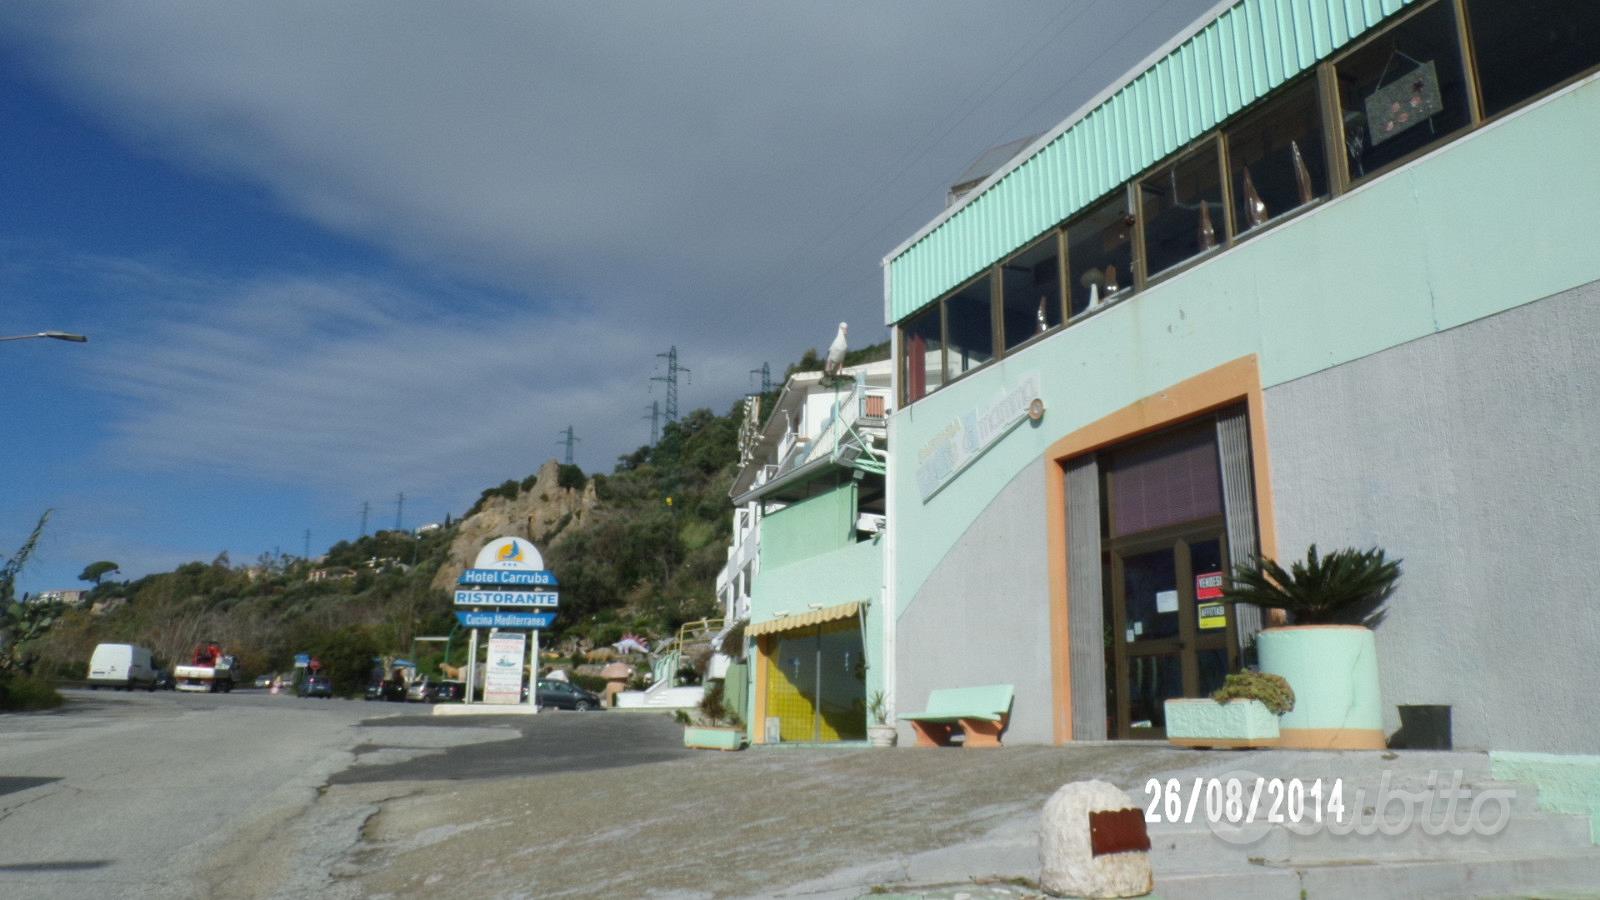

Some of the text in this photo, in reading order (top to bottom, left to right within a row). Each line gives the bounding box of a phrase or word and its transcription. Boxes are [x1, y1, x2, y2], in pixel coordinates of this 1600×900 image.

[466, 570, 549, 584] Hotel Carruba
[457, 592, 557, 605] RISTORANTE
[466, 614, 546, 626] Cucina Mediterranea
